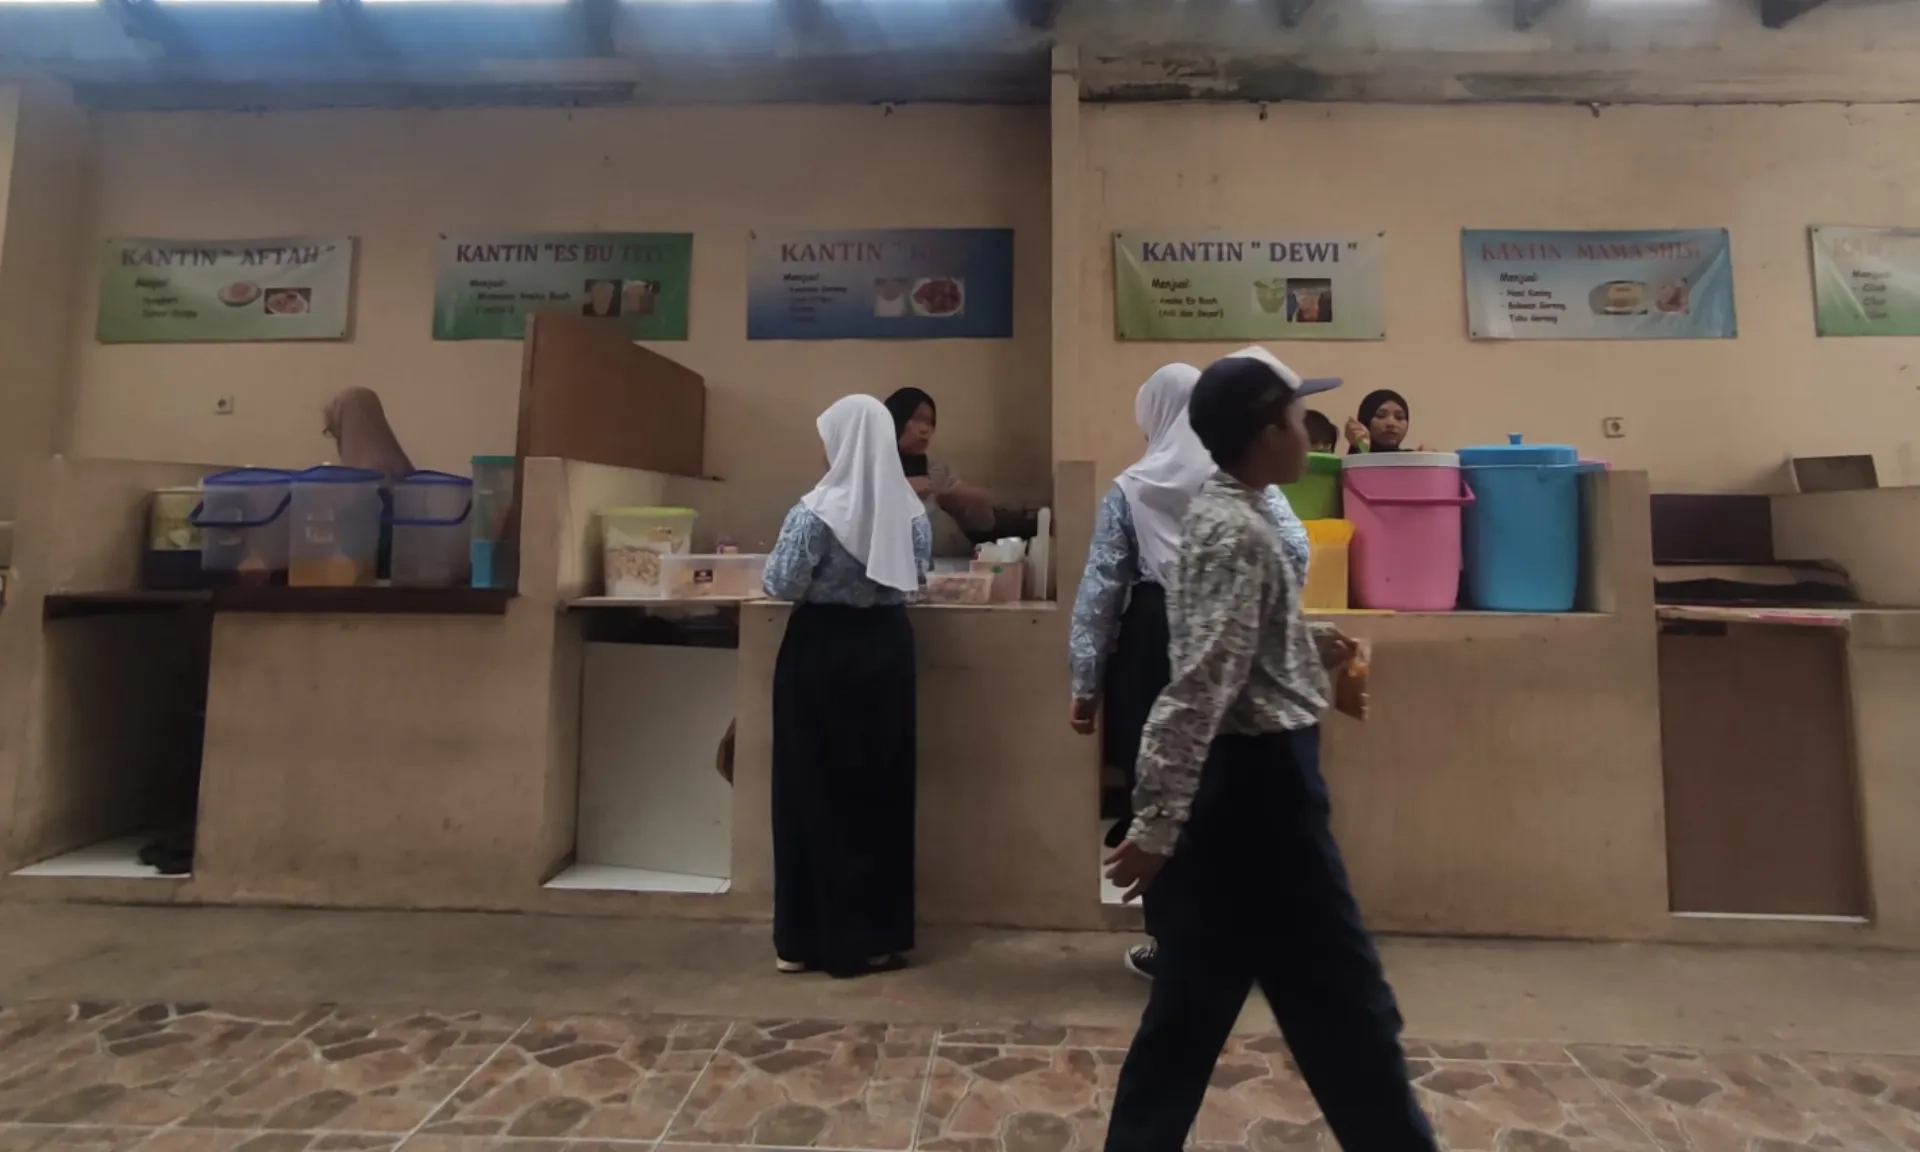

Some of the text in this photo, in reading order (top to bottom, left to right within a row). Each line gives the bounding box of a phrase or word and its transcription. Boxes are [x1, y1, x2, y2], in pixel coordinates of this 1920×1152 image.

[122, 248, 217, 266] KANTIN
[456, 244, 538, 262] KANTIN
[781, 243, 883, 262] KANTIN
[1142, 242, 1244, 262] KANTIN
[1269, 242, 1340, 262] DEWI
